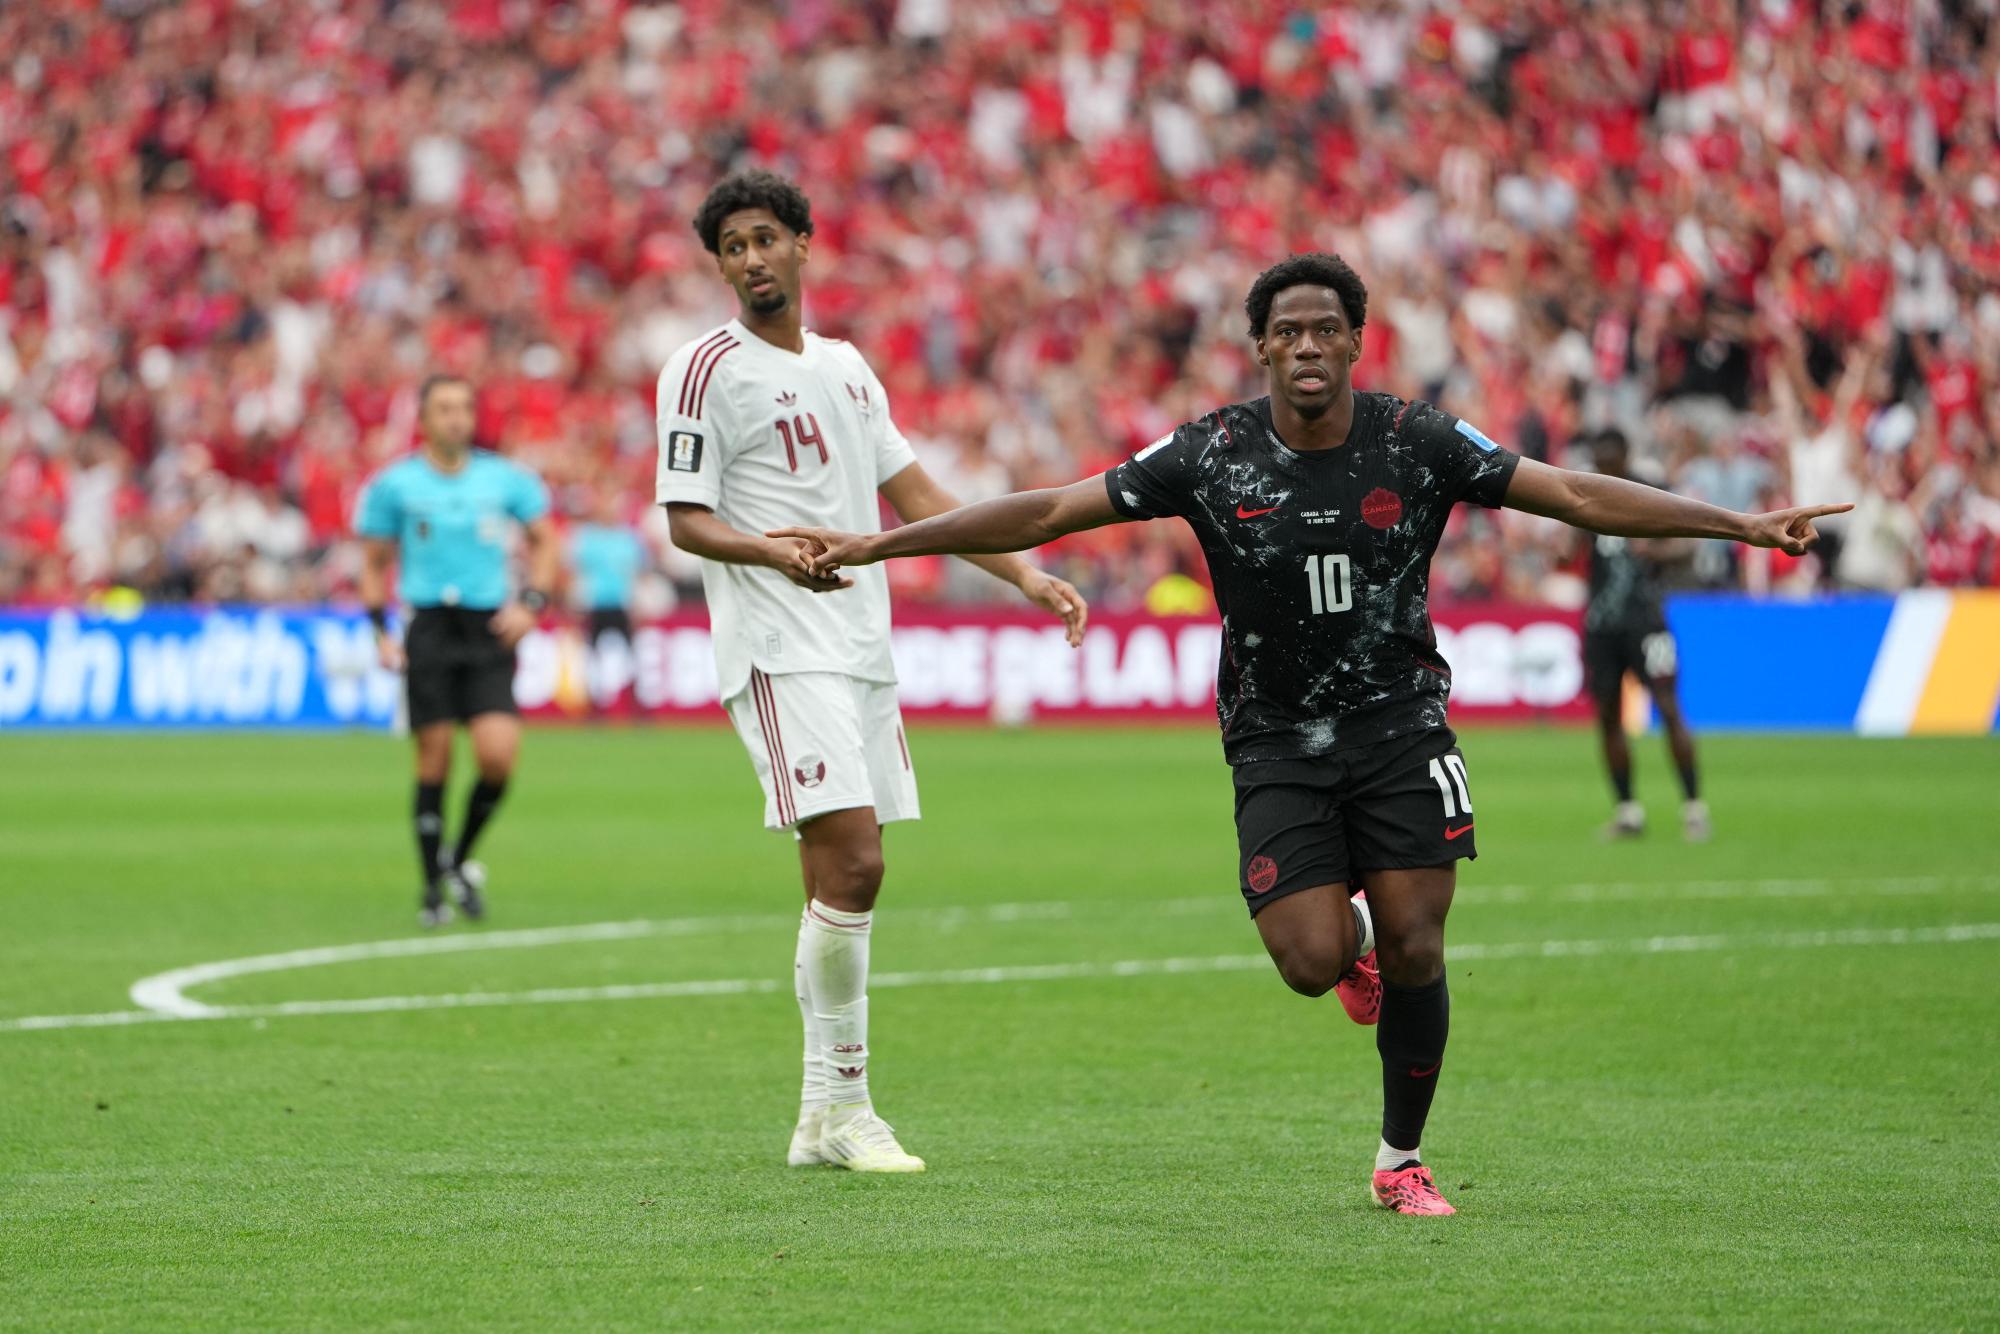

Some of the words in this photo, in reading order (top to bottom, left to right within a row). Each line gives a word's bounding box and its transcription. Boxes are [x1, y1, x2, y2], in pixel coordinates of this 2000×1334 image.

[775, 412, 829, 473] 14
[1363, 503, 1401, 515] CANADA
[1304, 554, 1353, 615] 10
[1084, 624, 1177, 708] LA
[1429, 755, 1473, 818] 10
